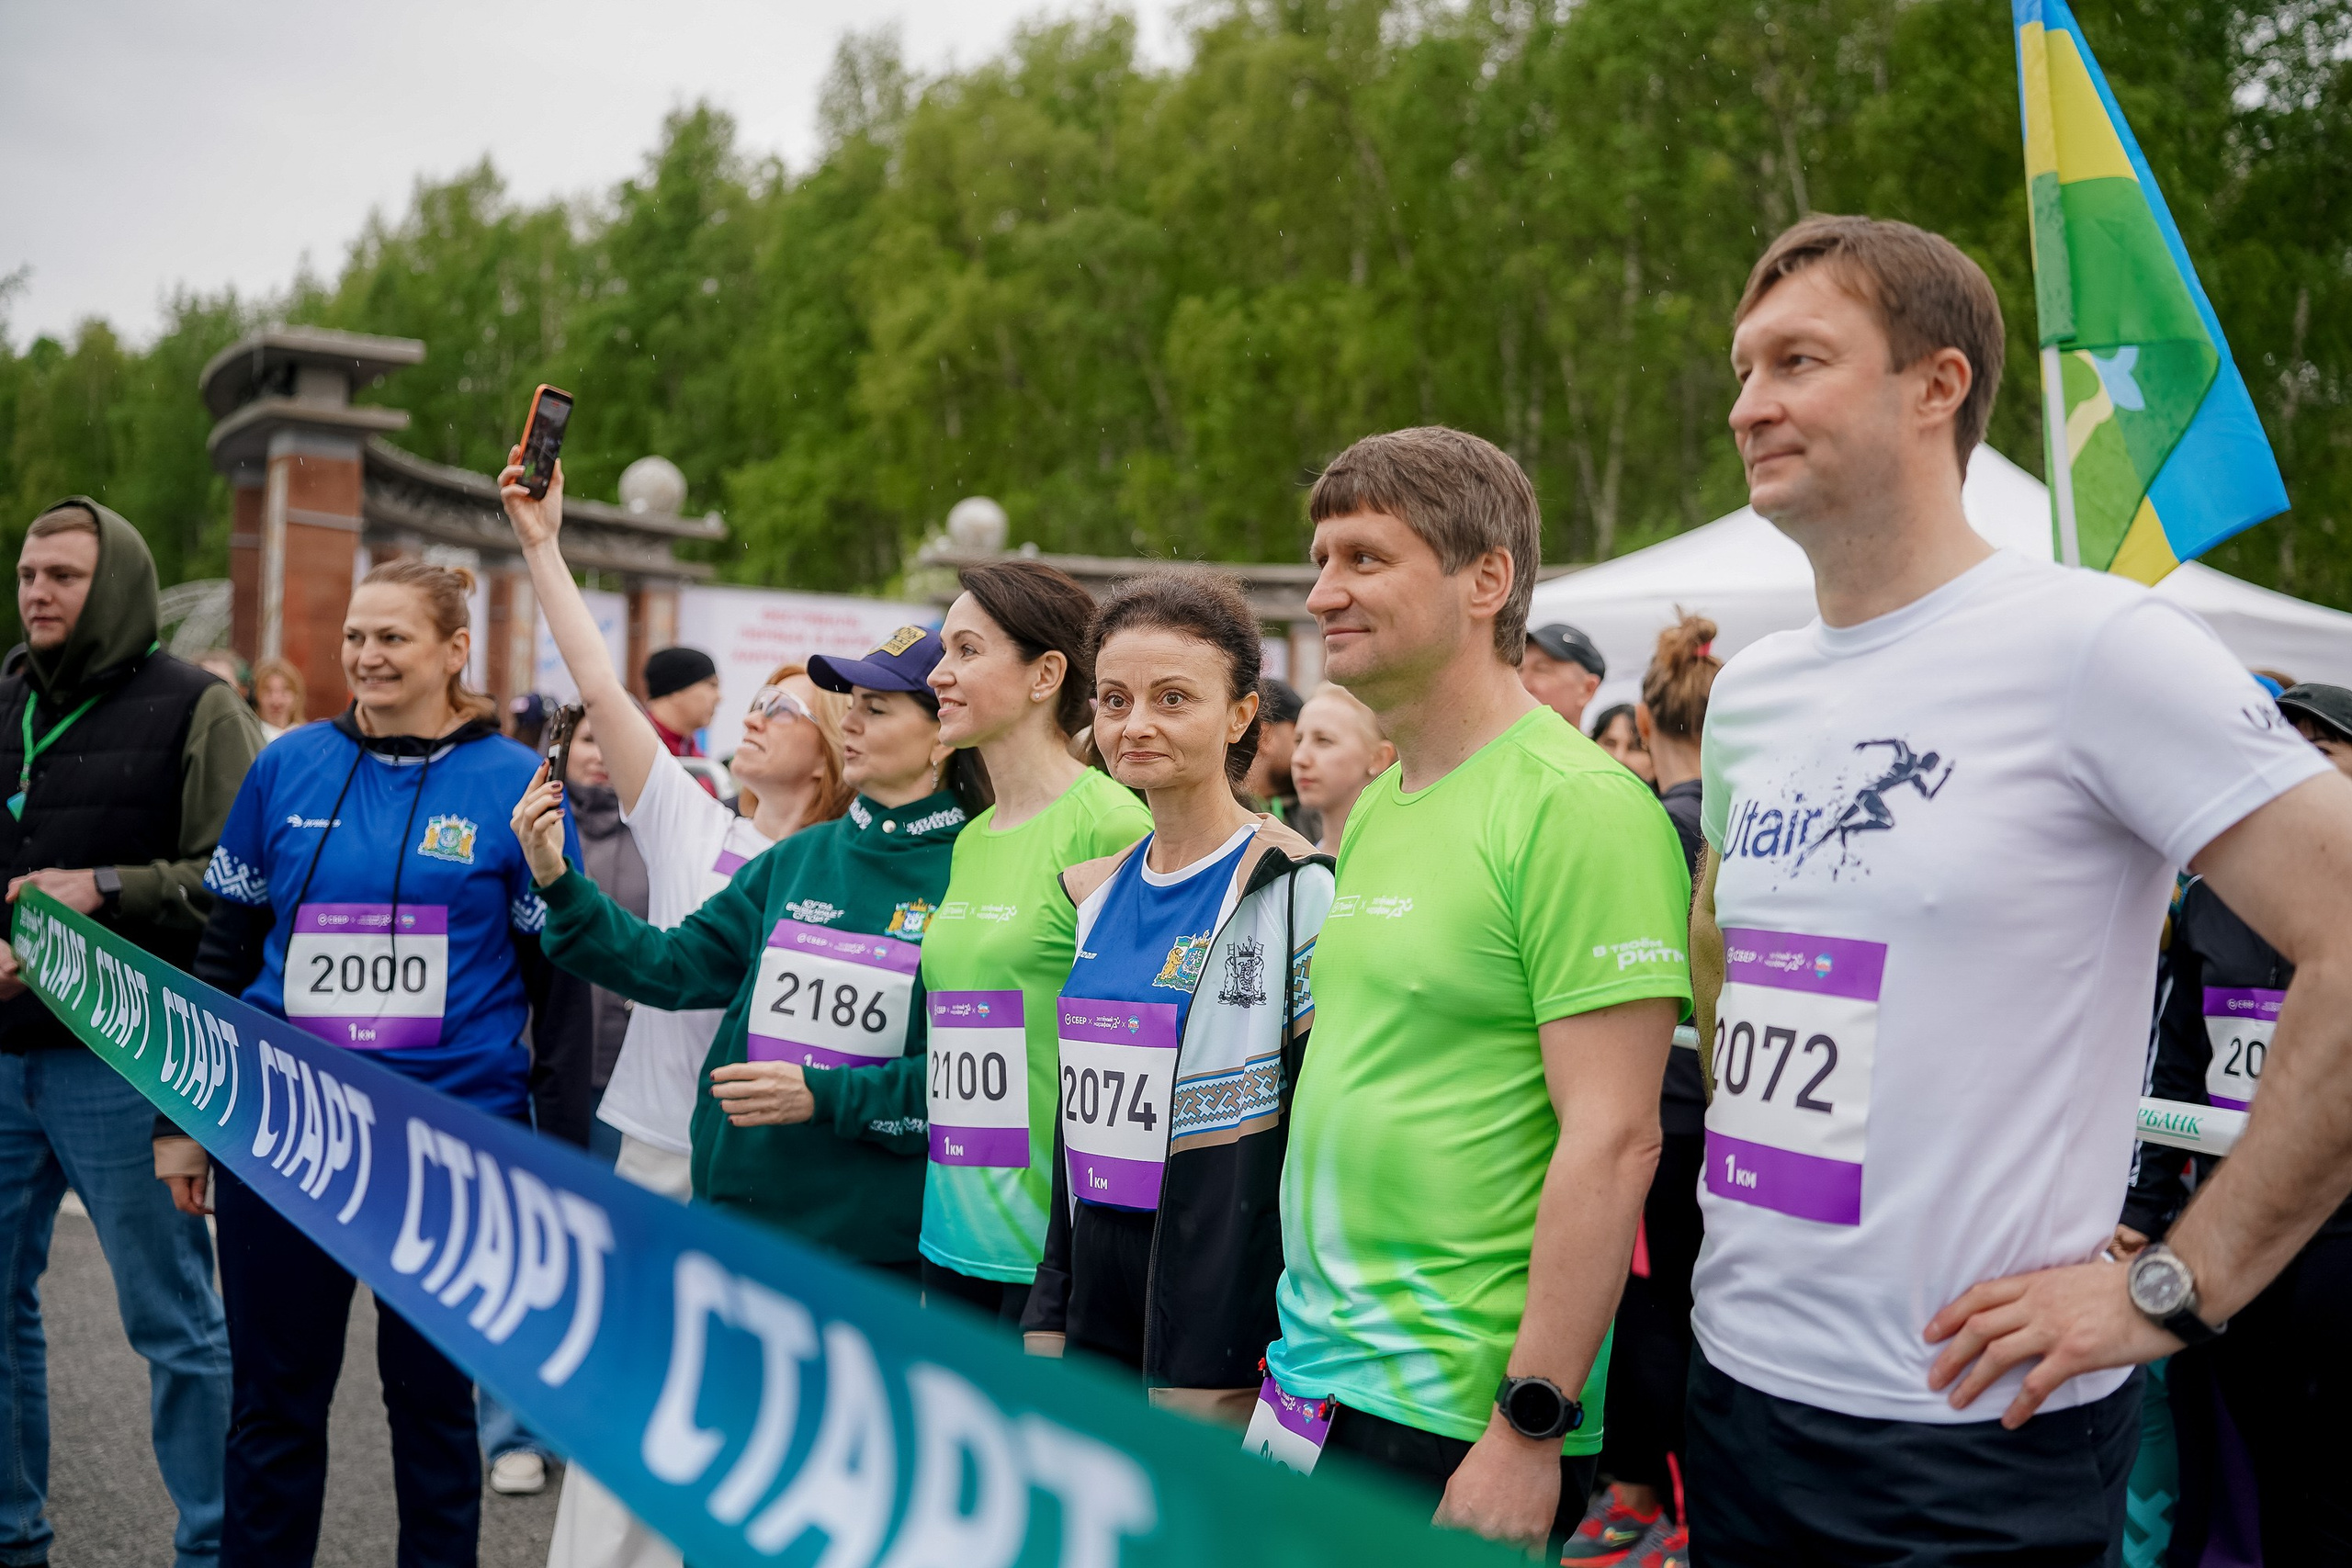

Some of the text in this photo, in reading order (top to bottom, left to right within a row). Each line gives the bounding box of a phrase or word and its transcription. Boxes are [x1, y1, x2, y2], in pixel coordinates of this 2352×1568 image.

[1724, 794, 1823, 862] Utair
[311, 955, 426, 993] 2000
[770, 972, 887, 1033] 2186
[1071, 1016, 1087, 1025] СБЕР
[932, 1051, 1007, 1100] 2100
[1064, 1065, 1158, 1132] 2074
[40, 915, 1158, 1568] СТАРТ СТАРТ СТАРТ СТАРТ СТАРТ СТАРТ
